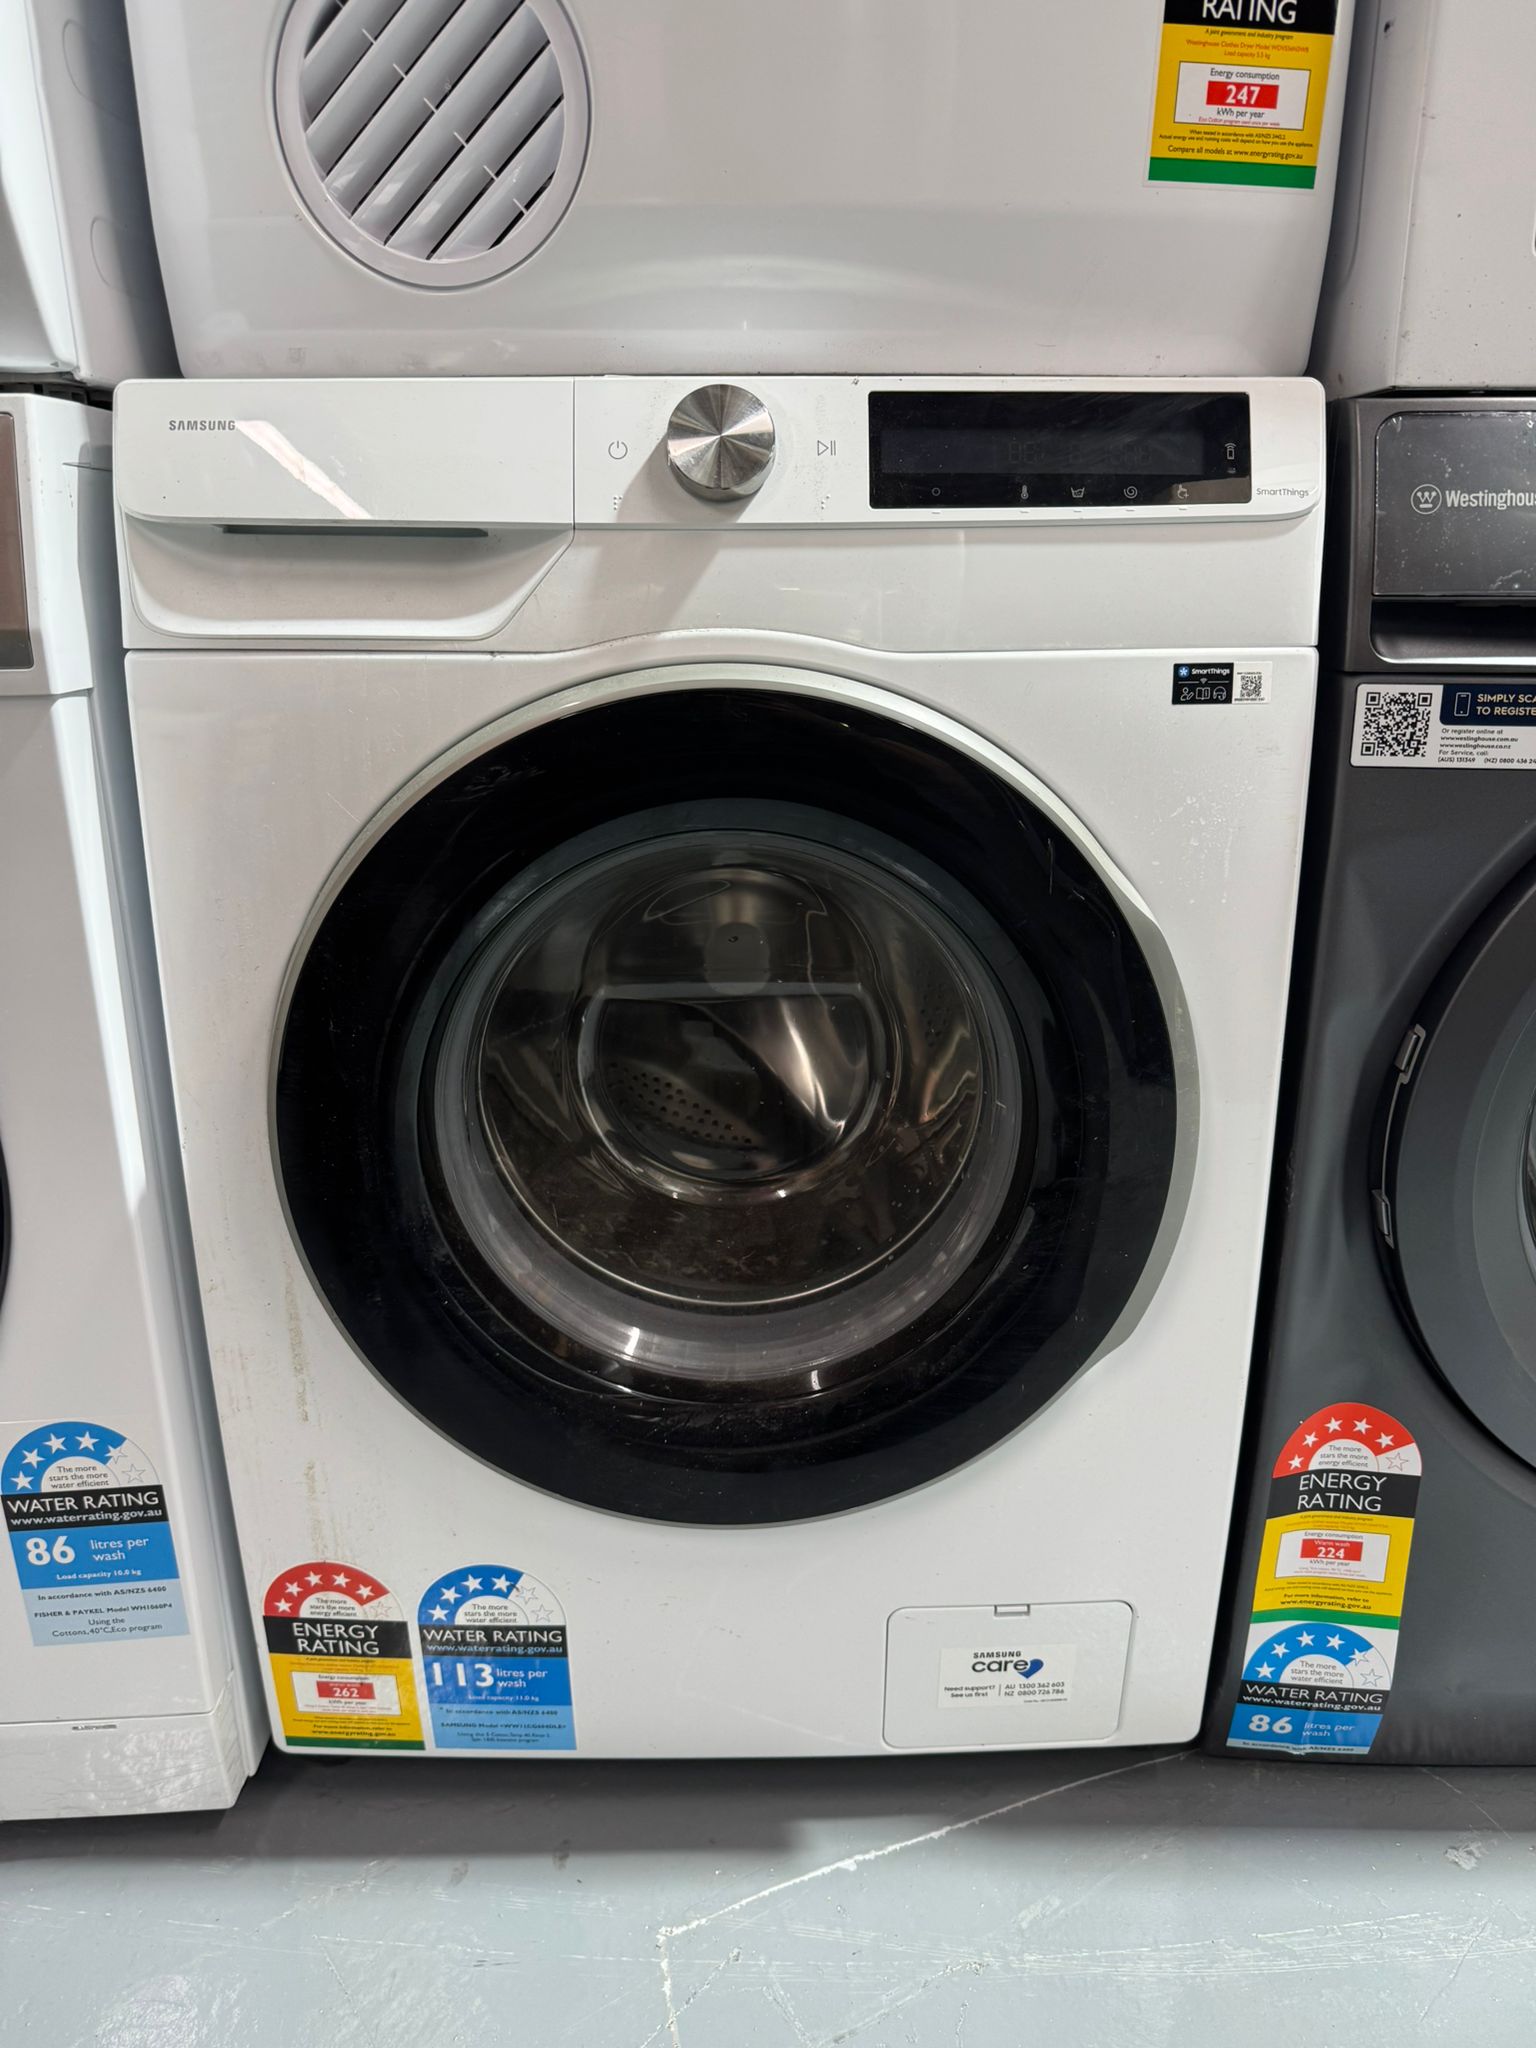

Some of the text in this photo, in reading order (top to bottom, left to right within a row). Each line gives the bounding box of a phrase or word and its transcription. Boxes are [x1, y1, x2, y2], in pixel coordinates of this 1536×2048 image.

[1202, 0, 1297, 24] RATING
[1210, 68, 1280, 82] Energy consumption
[1226, 84, 1260, 105] 247
[1216, 108, 1264, 119] kWh per year
[1168, 144, 1194, 154] Compare
[168, 420, 236, 431] SAMSUNG
[1256, 488, 1310, 498] SmartThings
[1445, 489, 1536, 510] Westinghou
[1191, 667, 1230, 676] SmartThings
[1477, 694, 1516, 703] SIMPLY
[1476, 706, 1490, 715] TO
[1299, 1472, 1387, 1491] ENERGY
[6, 1491, 160, 1514] WATER RATING
[1297, 1493, 1382, 1512] RATING
[11, 1509, 162, 1526] www.waterrating.gov.au
[26, 1535, 149, 1566] 86 litres per
[92, 1550, 126, 1561] wash
[1317, 1547, 1345, 1559] 224
[78, 1571, 111, 1579] capacity
[48, 1592, 94, 1600] accordance
[88, 1618, 110, 1626] Using
[130, 1624, 162, 1633] program
[292, 1622, 379, 1639] ENERGY
[423, 1629, 563, 1643] WATER RATING
[296, 1639, 380, 1655] RATING
[426, 1644, 563, 1654] www.waterrating.gov.au
[973, 1651, 1022, 1659] SAMSUNG
[971, 1659, 1029, 1673] care
[496, 1668, 525, 1678] litres
[528, 1670, 548, 1680] per
[497, 1679, 526, 1688] wash
[1314, 1676, 1343, 1685] efficient
[332, 1687, 360, 1697] 262
[1246, 1684, 1384, 1703] WATER RATING
[1242, 1695, 1381, 1711] www.waterrating.gov.au
[1248, 1714, 1293, 1734] 86
